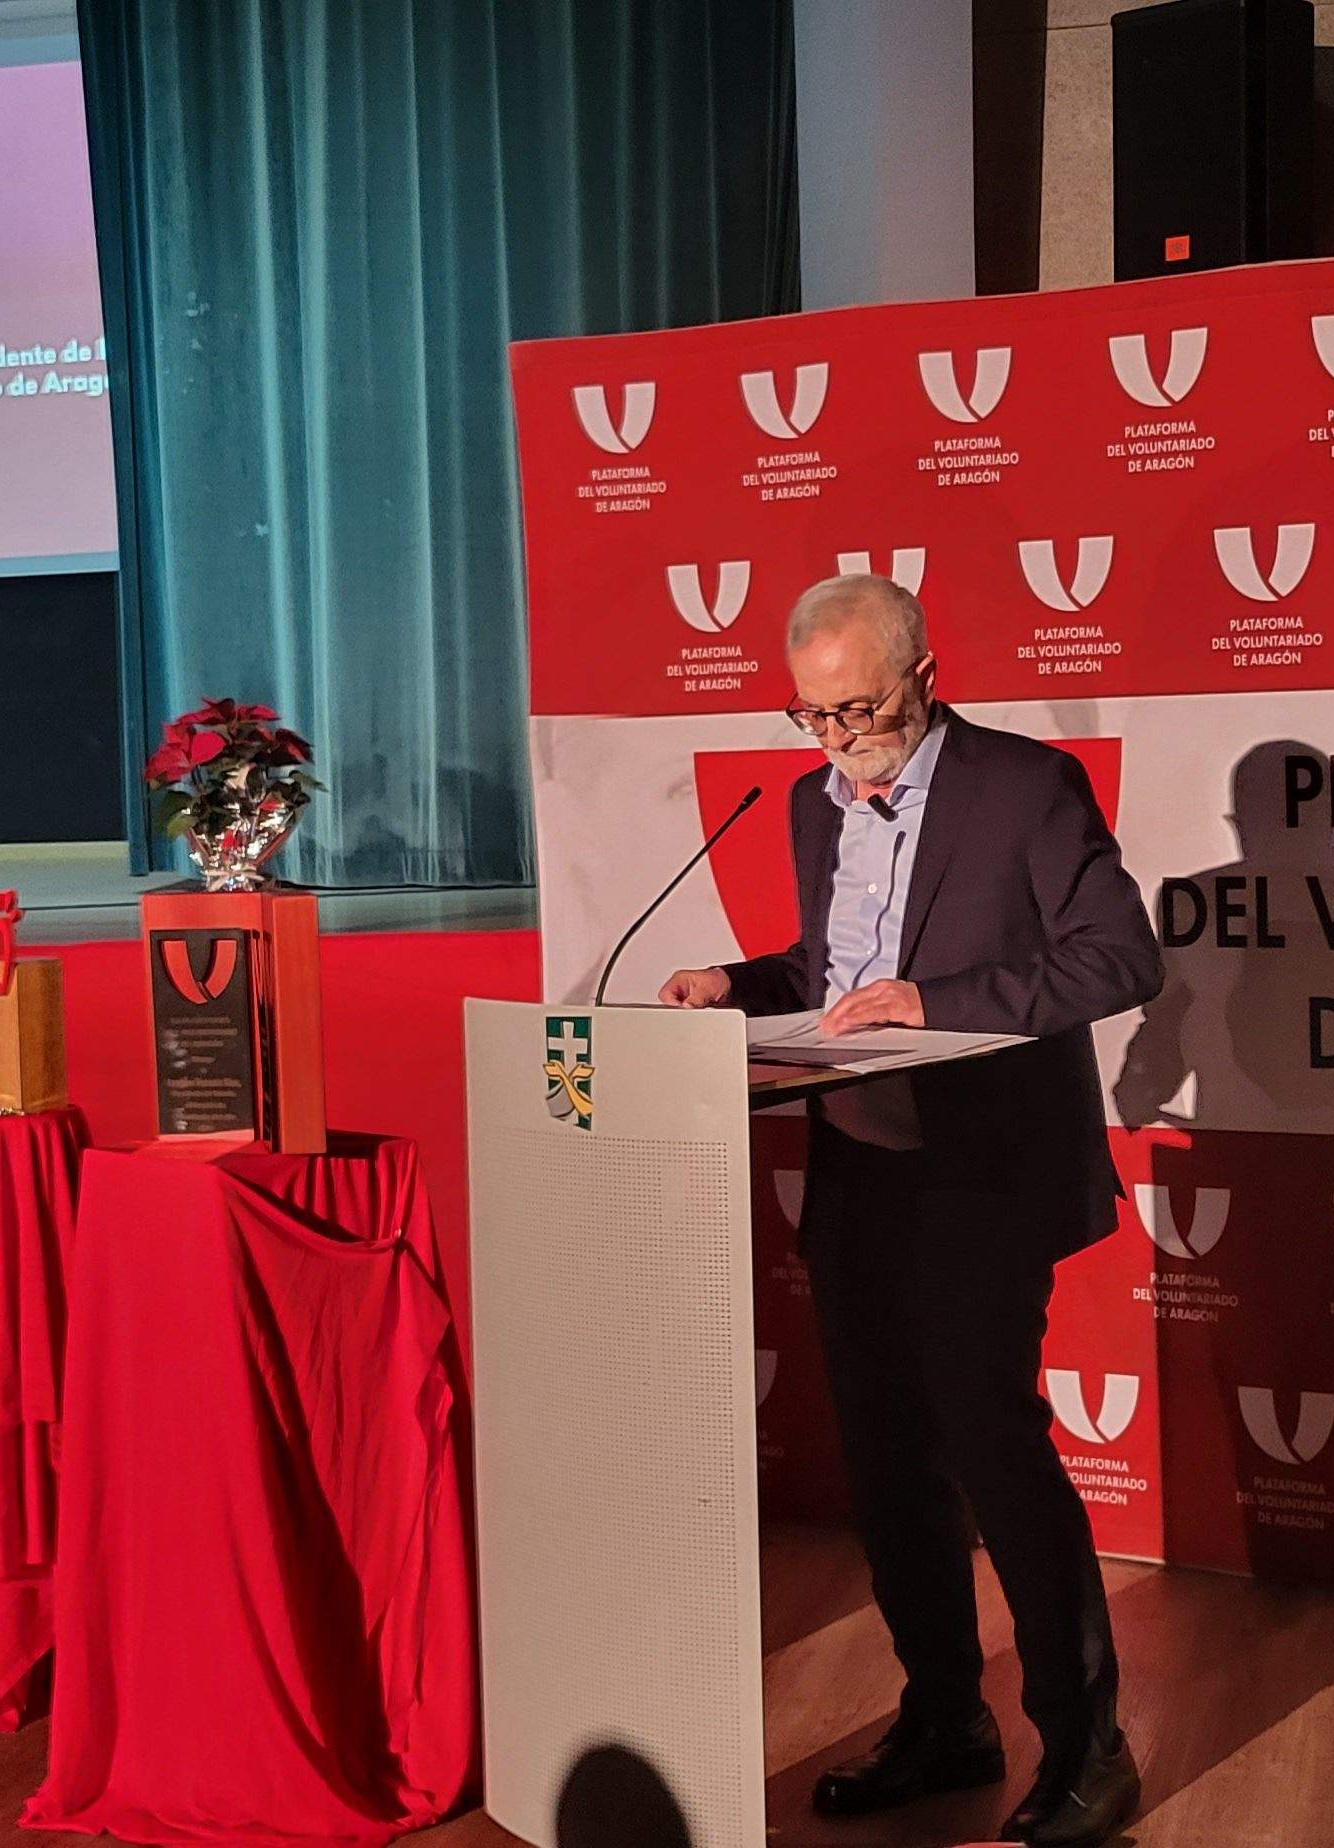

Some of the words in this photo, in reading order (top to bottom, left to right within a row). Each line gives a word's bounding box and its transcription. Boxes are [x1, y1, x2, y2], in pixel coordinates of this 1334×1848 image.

[61, 337, 92, 363] de
[7, 371, 38, 396] de
[41, 370, 109, 397] Arag
[1125, 421, 1196, 438] PLATAFORMA
[1309, 428, 1329, 441] DEL
[935, 437, 1001, 451] PLATAFORMA
[1107, 444, 1126, 456] DEL
[1128, 437, 1215, 454] VOLUNTARIADO
[758, 452, 820, 468] PLATAFORMA
[919, 459, 936, 470] DEL
[938, 453, 1019, 468] VOLUNTARIADO
[1128, 461, 1141, 472] DE
[1145, 454, 1194, 471] ARAGÓN
[743, 475, 759, 486] DEL
[761, 466, 837, 484] VOLUNTARIADO
[938, 474, 950, 486] DE
[954, 469, 999, 484] ARAGÓN
[762, 490, 774, 500] DE
[776, 483, 819, 499] ARAGÓN
[1230, 617, 1303, 631] PLATAFORMA
[1035, 626, 1103, 640] PLATAFORMA
[1212, 638, 1230, 649] DEL
[1234, 634, 1323, 648] VOLUNTARIADO
[682, 646, 742, 659] PLATAFORMA
[1018, 647, 1036, 658] DEL
[1038, 642, 1121, 657] VOLUNTARIADO
[1234, 654, 1247, 666] DE
[1250, 650, 1301, 665] ARAGÓN
[668, 665, 683, 676] DEL
[685, 661, 758, 675] VOLUNTARIADO
[1038, 663, 1051, 674] DE
[1054, 658, 1101, 673] ARAGÓN
[685, 681, 696, 691] DE
[699, 676, 740, 690] ARAGÓN
[1161, 876, 1286, 949] DEL
[1068, 1472, 1147, 1491] OLUNTARIADO
